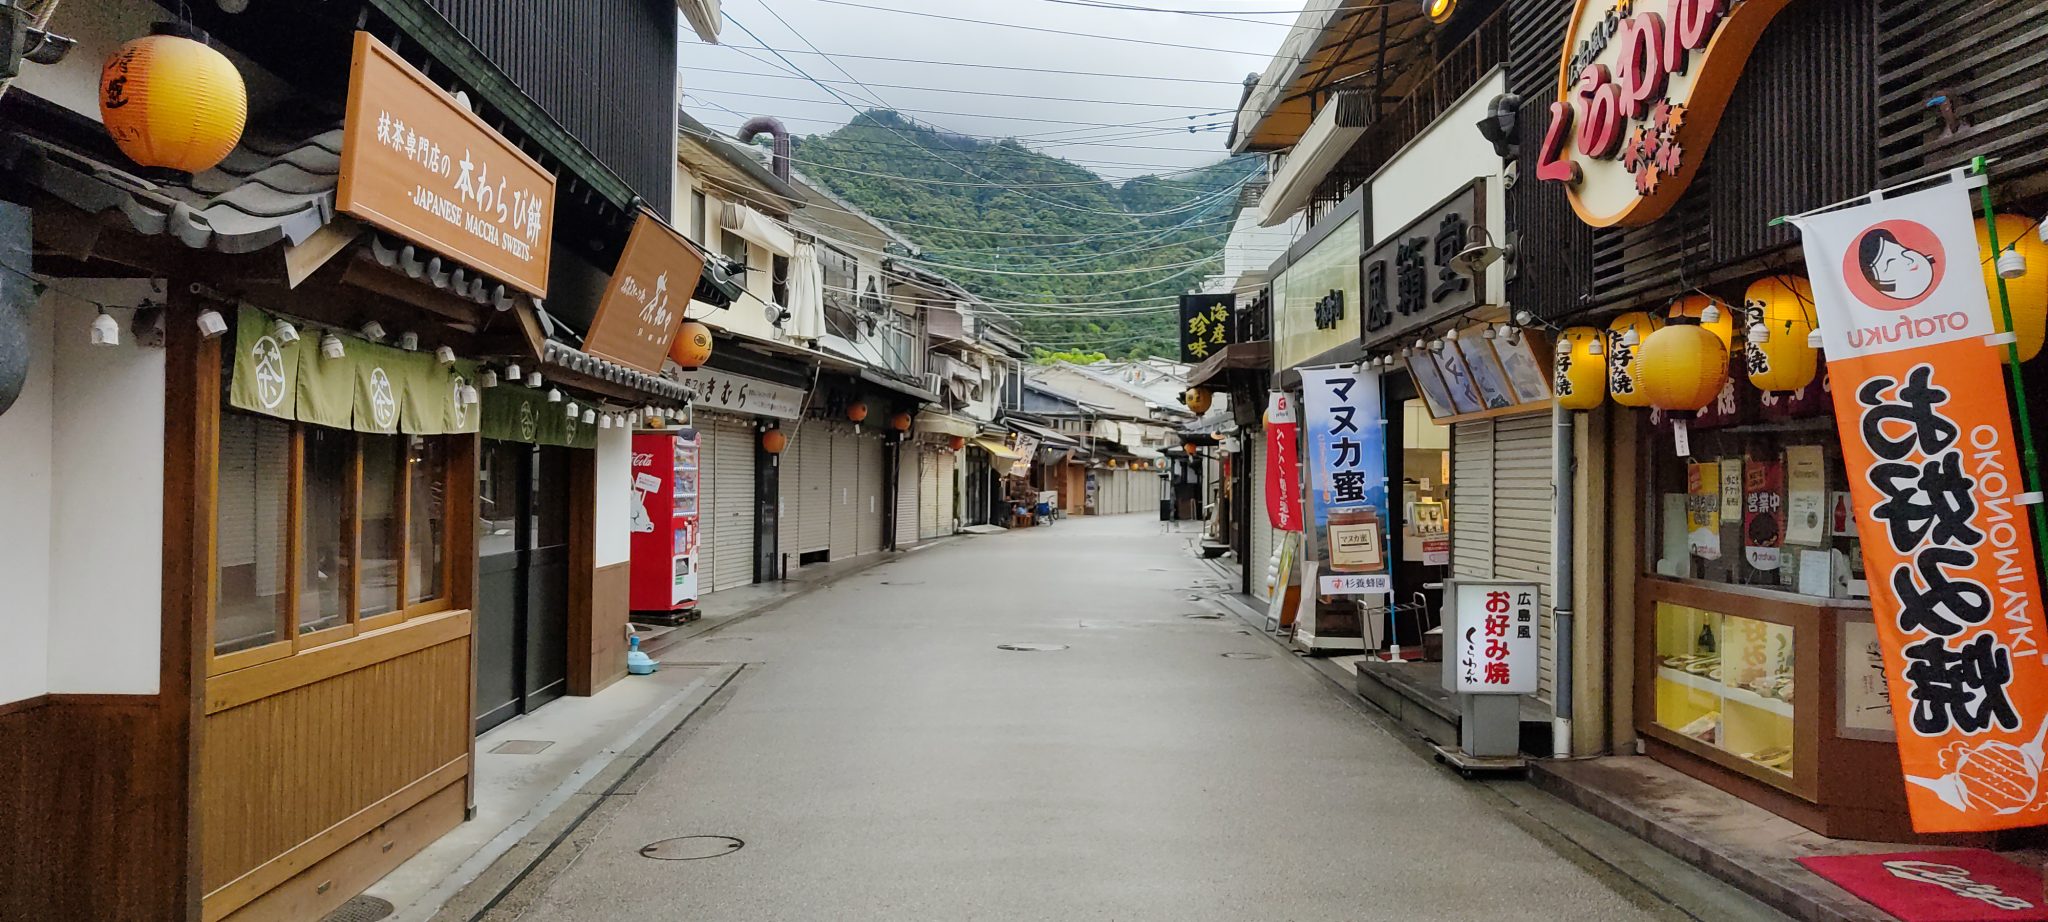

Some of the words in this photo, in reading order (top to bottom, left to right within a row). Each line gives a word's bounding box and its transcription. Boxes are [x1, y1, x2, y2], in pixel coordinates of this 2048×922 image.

[377, 109, 450, 178] 抹茶専門店の
[454, 148, 542, 248] 本わらび餅
[465, 212, 499, 247] MACCHA
[1187, 312, 1211, 358] 珍味
[1210, 302, 1230, 344] 海産
[1745, 300, 1769, 375] おみ焼
[254, 338, 283, 403] 茶
[705, 376, 749, 408] きむら
[370, 375, 394, 424] 茶
[1324, 376, 1367, 503] マヌカ蜜
[1747, 492, 1780, 513] 営業中
[1345, 577, 1386, 589] 杉養蜂園
[1485, 591, 1510, 684] お好み焼
[1517, 592, 1531, 639] 広島風
[1463, 627, 1478, 685] くらわんか
